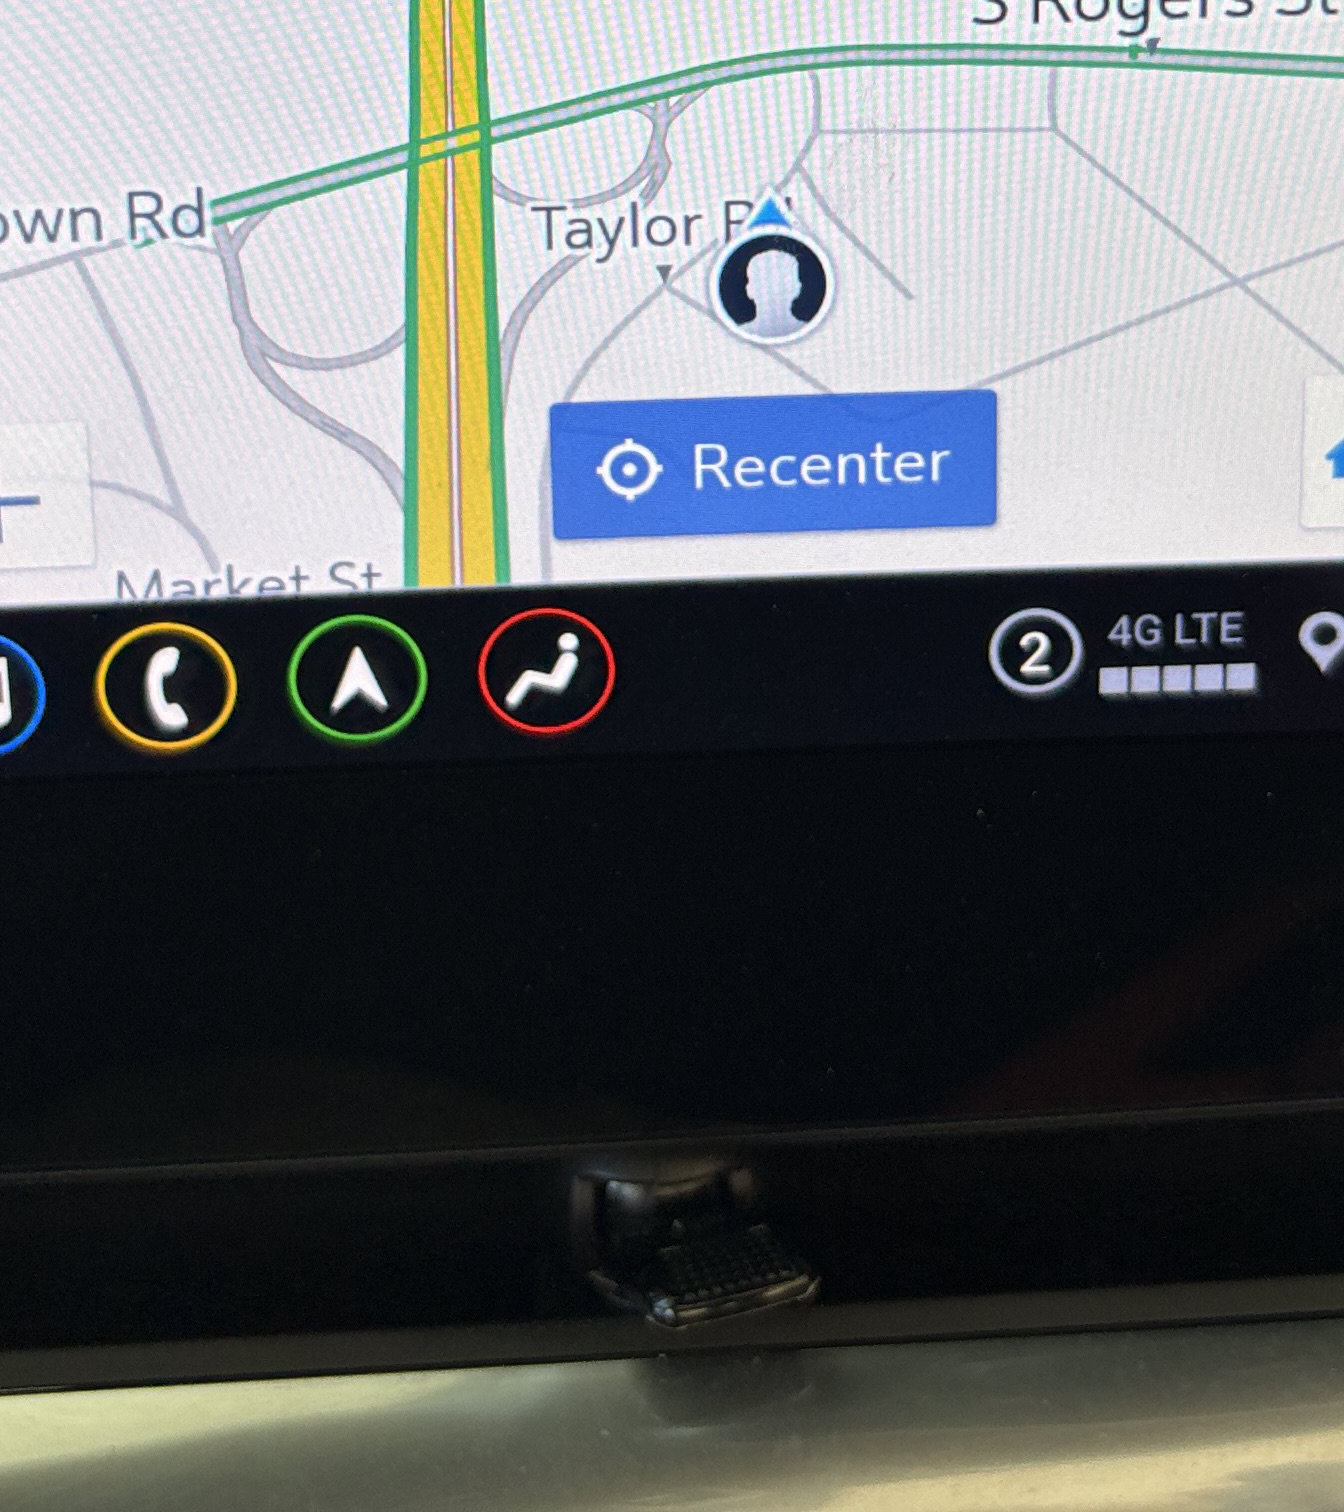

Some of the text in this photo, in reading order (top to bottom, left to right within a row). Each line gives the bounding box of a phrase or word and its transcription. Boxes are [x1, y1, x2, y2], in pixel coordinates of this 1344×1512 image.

[126, 185, 207, 241] Rd
[530, 200, 703, 264] Taylor
[693, 441, 952, 490] Recenter
[328, 560, 383, 593] St
[1018, 629, 1053, 676] 2
[1106, 610, 1246, 647] 4G LTE
